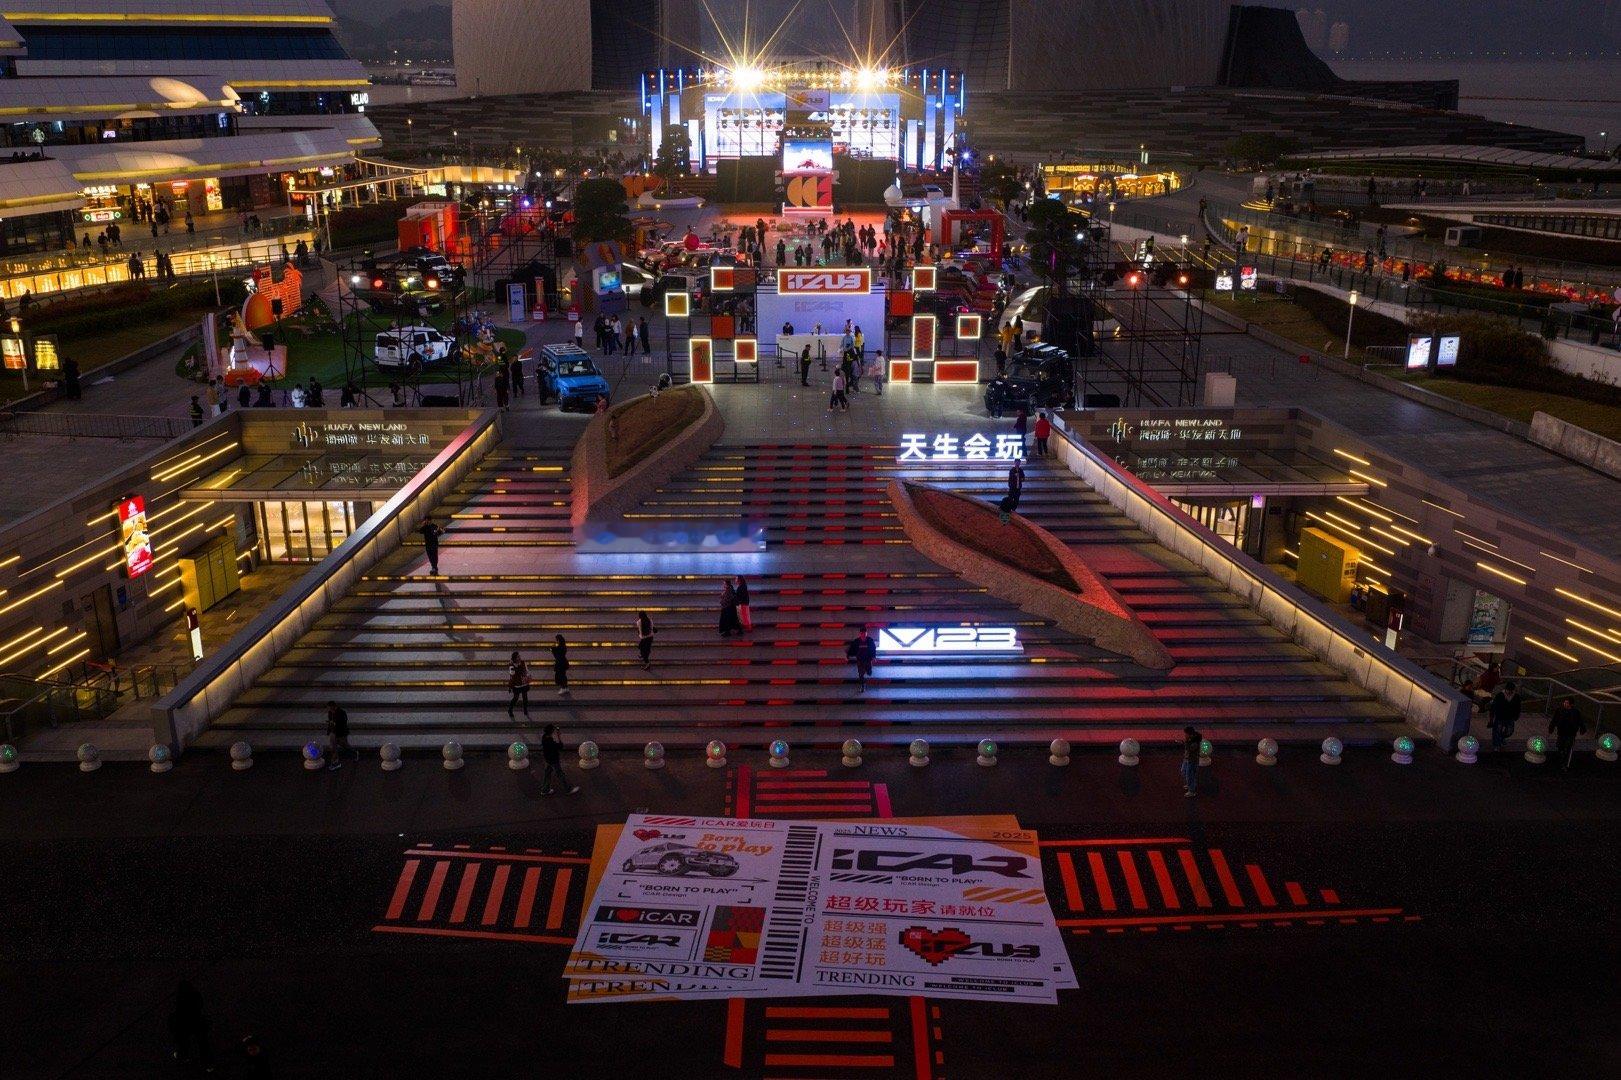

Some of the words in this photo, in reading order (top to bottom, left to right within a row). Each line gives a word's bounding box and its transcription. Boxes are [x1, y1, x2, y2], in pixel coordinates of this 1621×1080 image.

[324, 423, 355, 431] HUAFA
[358, 423, 408, 431] NEWLAND
[1140, 419, 1171, 427] HUAFA
[1175, 419, 1223, 427] NEWLAND
[900, 433, 1023, 461] 天生会玩
[703, 833, 745, 842] Born
[854, 825, 908, 836] NEWS
[992, 831, 1032, 840] 2025
[697, 840, 717, 851] to
[721, 843, 773, 856] play
[806, 875, 821, 912] WELCOME
[607, 909, 614, 920] I
[638, 911, 693, 924] iCAR
[804, 913, 815, 924] TO
[823, 920, 887, 934] 超级强
[821, 935, 887, 950] 超级猛
[819, 951, 887, 966] 超好玩
[580, 959, 749, 979] TRENDING
[816, 971, 915, 987] TRENDING
